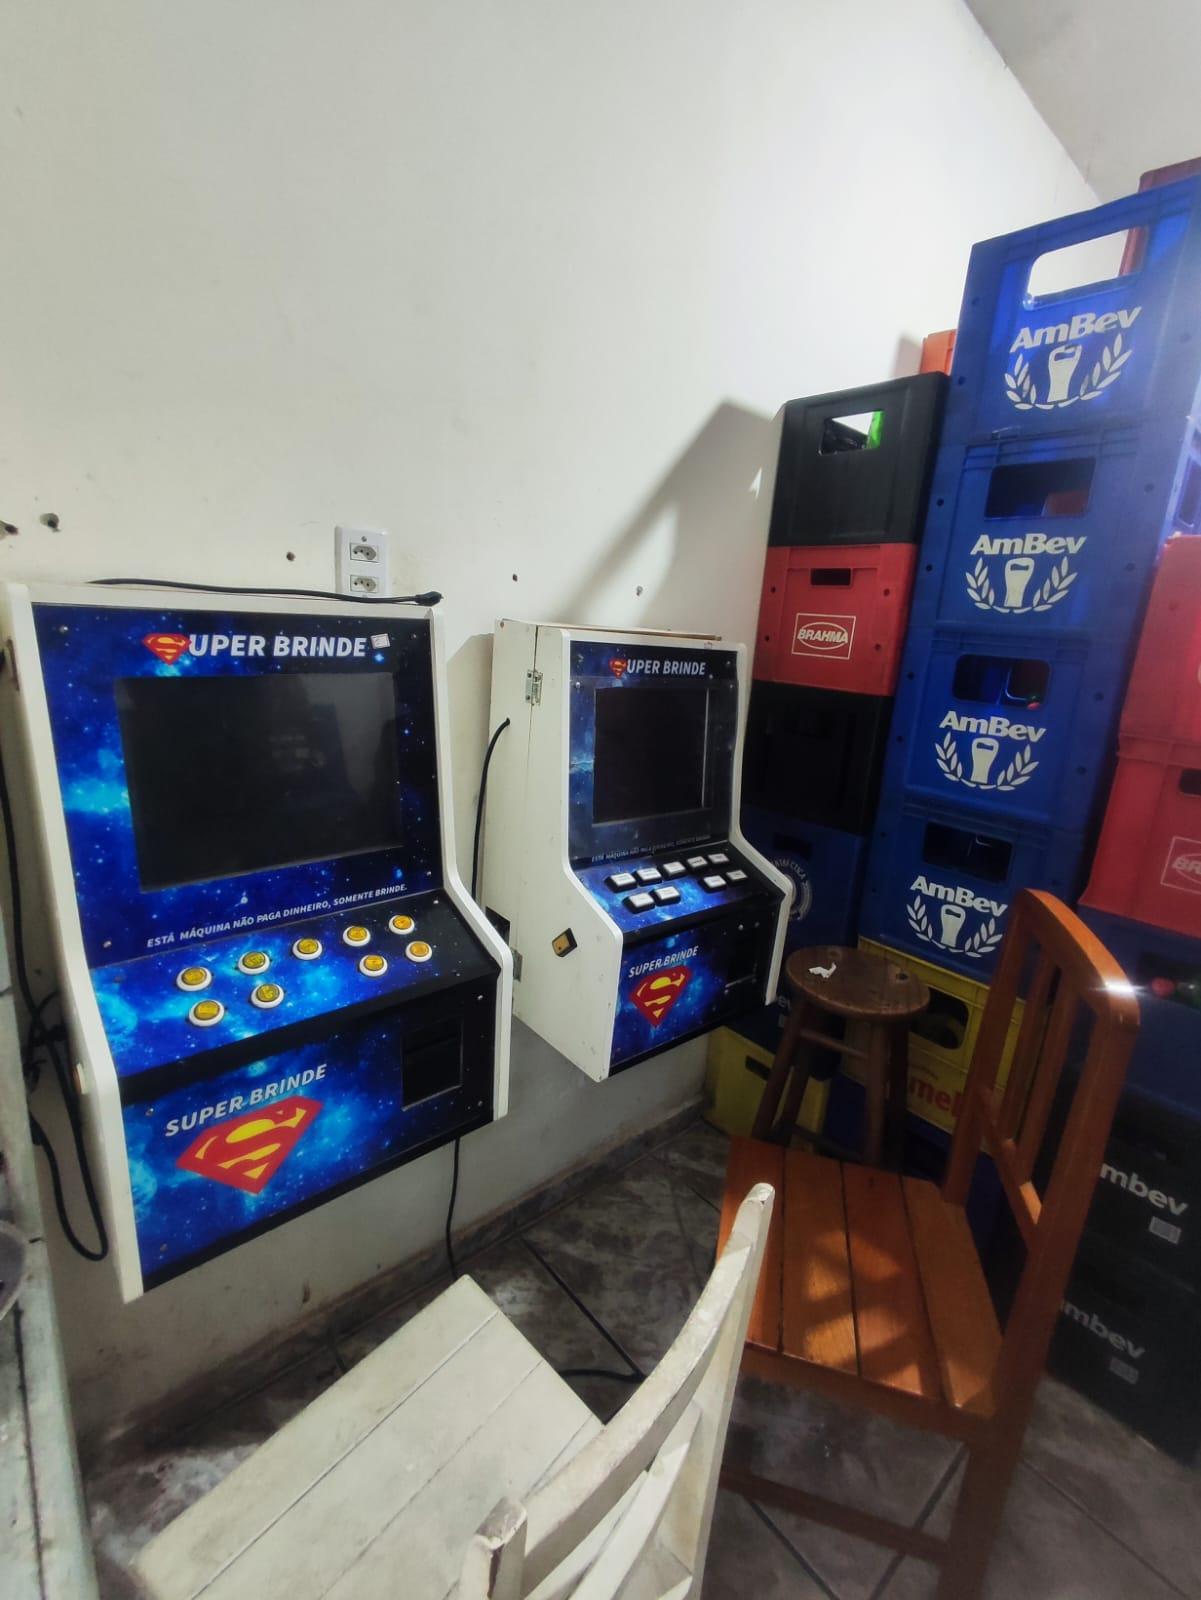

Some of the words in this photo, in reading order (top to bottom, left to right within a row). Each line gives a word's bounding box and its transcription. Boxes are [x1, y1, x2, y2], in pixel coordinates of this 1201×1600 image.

[1009, 306, 1142, 354] AmBev
[970, 533, 1086, 556] AmBev
[273, 636, 367, 657] BRINDE
[797, 628, 849, 643] BRAHMA
[663, 661, 706, 675] BRINDE
[938, 710, 1047, 743] AmBev
[147, 932, 174, 948] ESTÁ
[179, 921, 231, 941] MÁQUINA
[232, 911, 255, 928] NÃO
[256, 911, 282, 923] PAGA
[283, 900, 332, 918] DINHEIRO,
[333, 891, 374, 906] SOMENTE
[375, 883, 408, 896] BRINDE.
[909, 875, 1008, 918] AmBev
[628, 957, 665, 978] SUPER
[663, 945, 699, 967] BRINDE
[165, 1095, 244, 1137] SUPER
[245, 1063, 327, 1106] BRINDE
[1100, 1162, 1188, 1216] mbev
[1062, 1301, 1146, 1359] mbev
